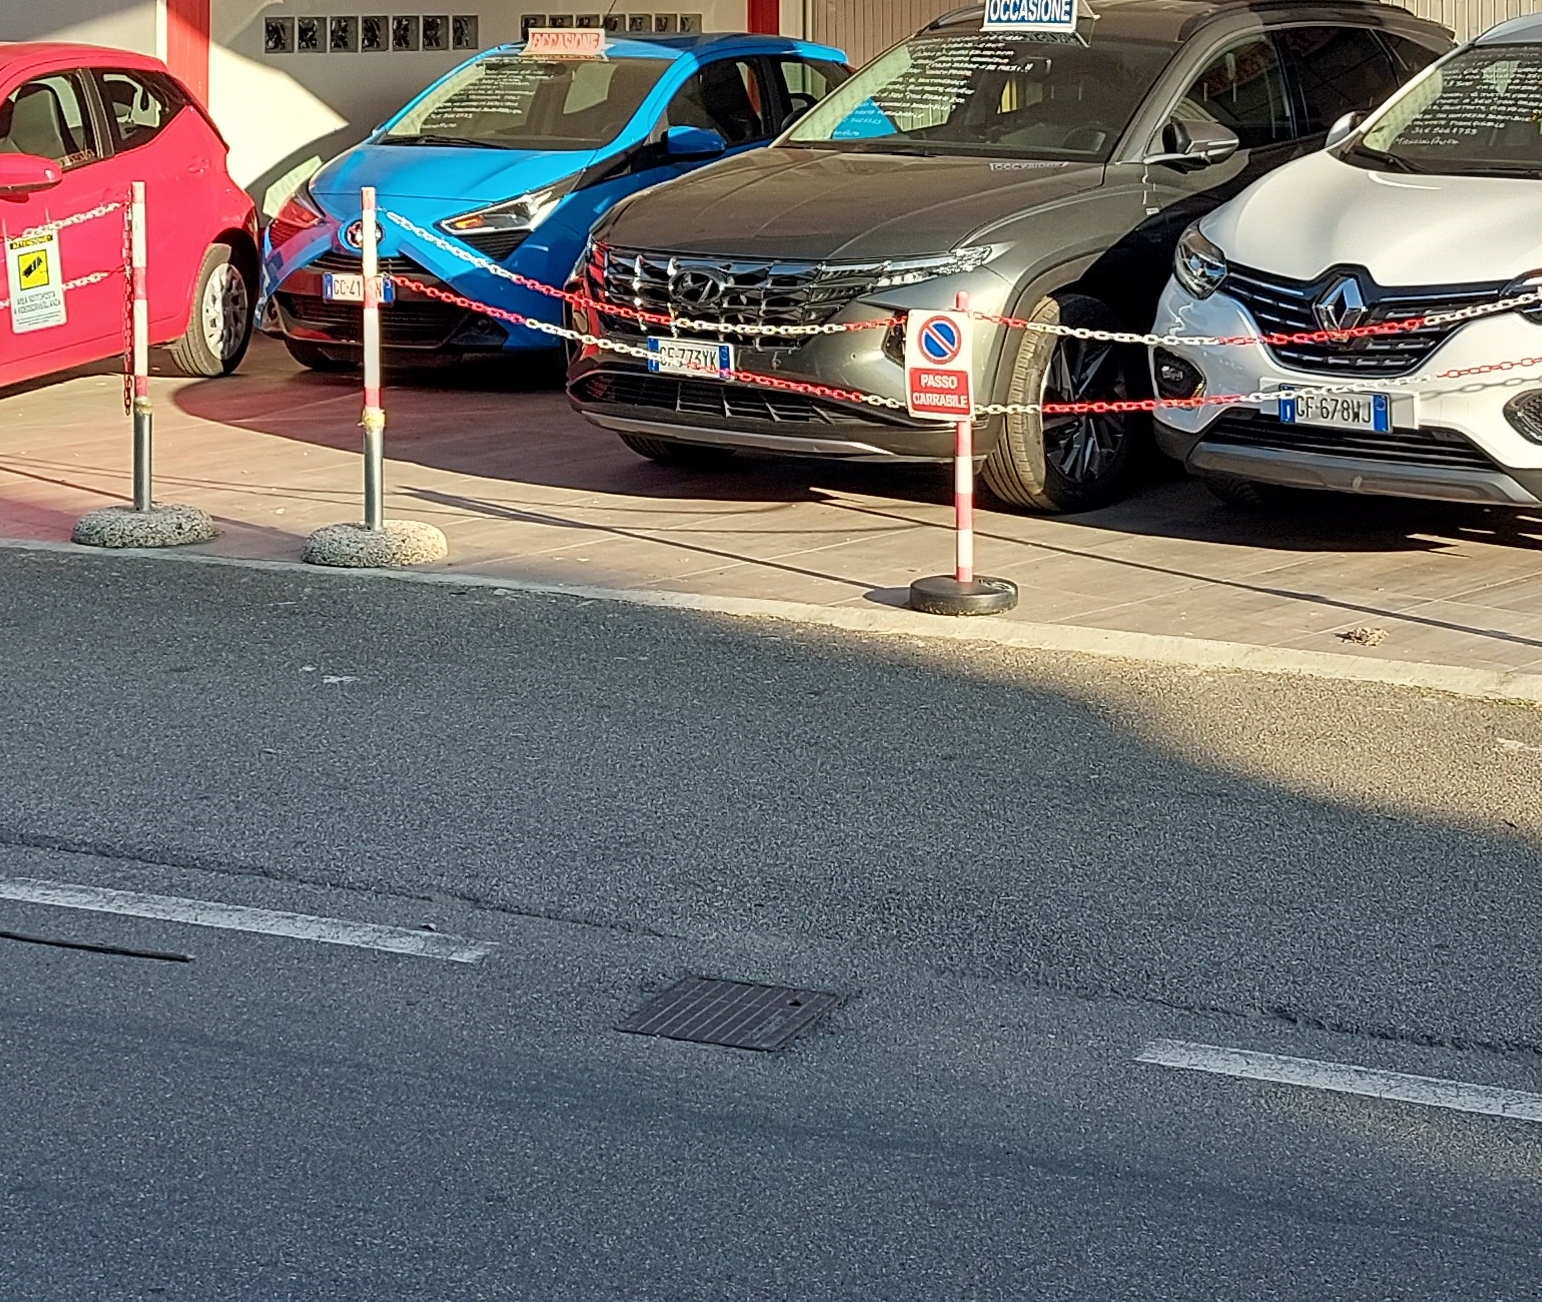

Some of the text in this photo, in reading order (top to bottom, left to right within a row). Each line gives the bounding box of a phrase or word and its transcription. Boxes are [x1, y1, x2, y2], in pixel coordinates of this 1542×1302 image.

[531, 33, 600, 48] OCCASIONE
[920, 374, 958, 389] PASSO
[912, 392, 969, 409] CARRABILE
